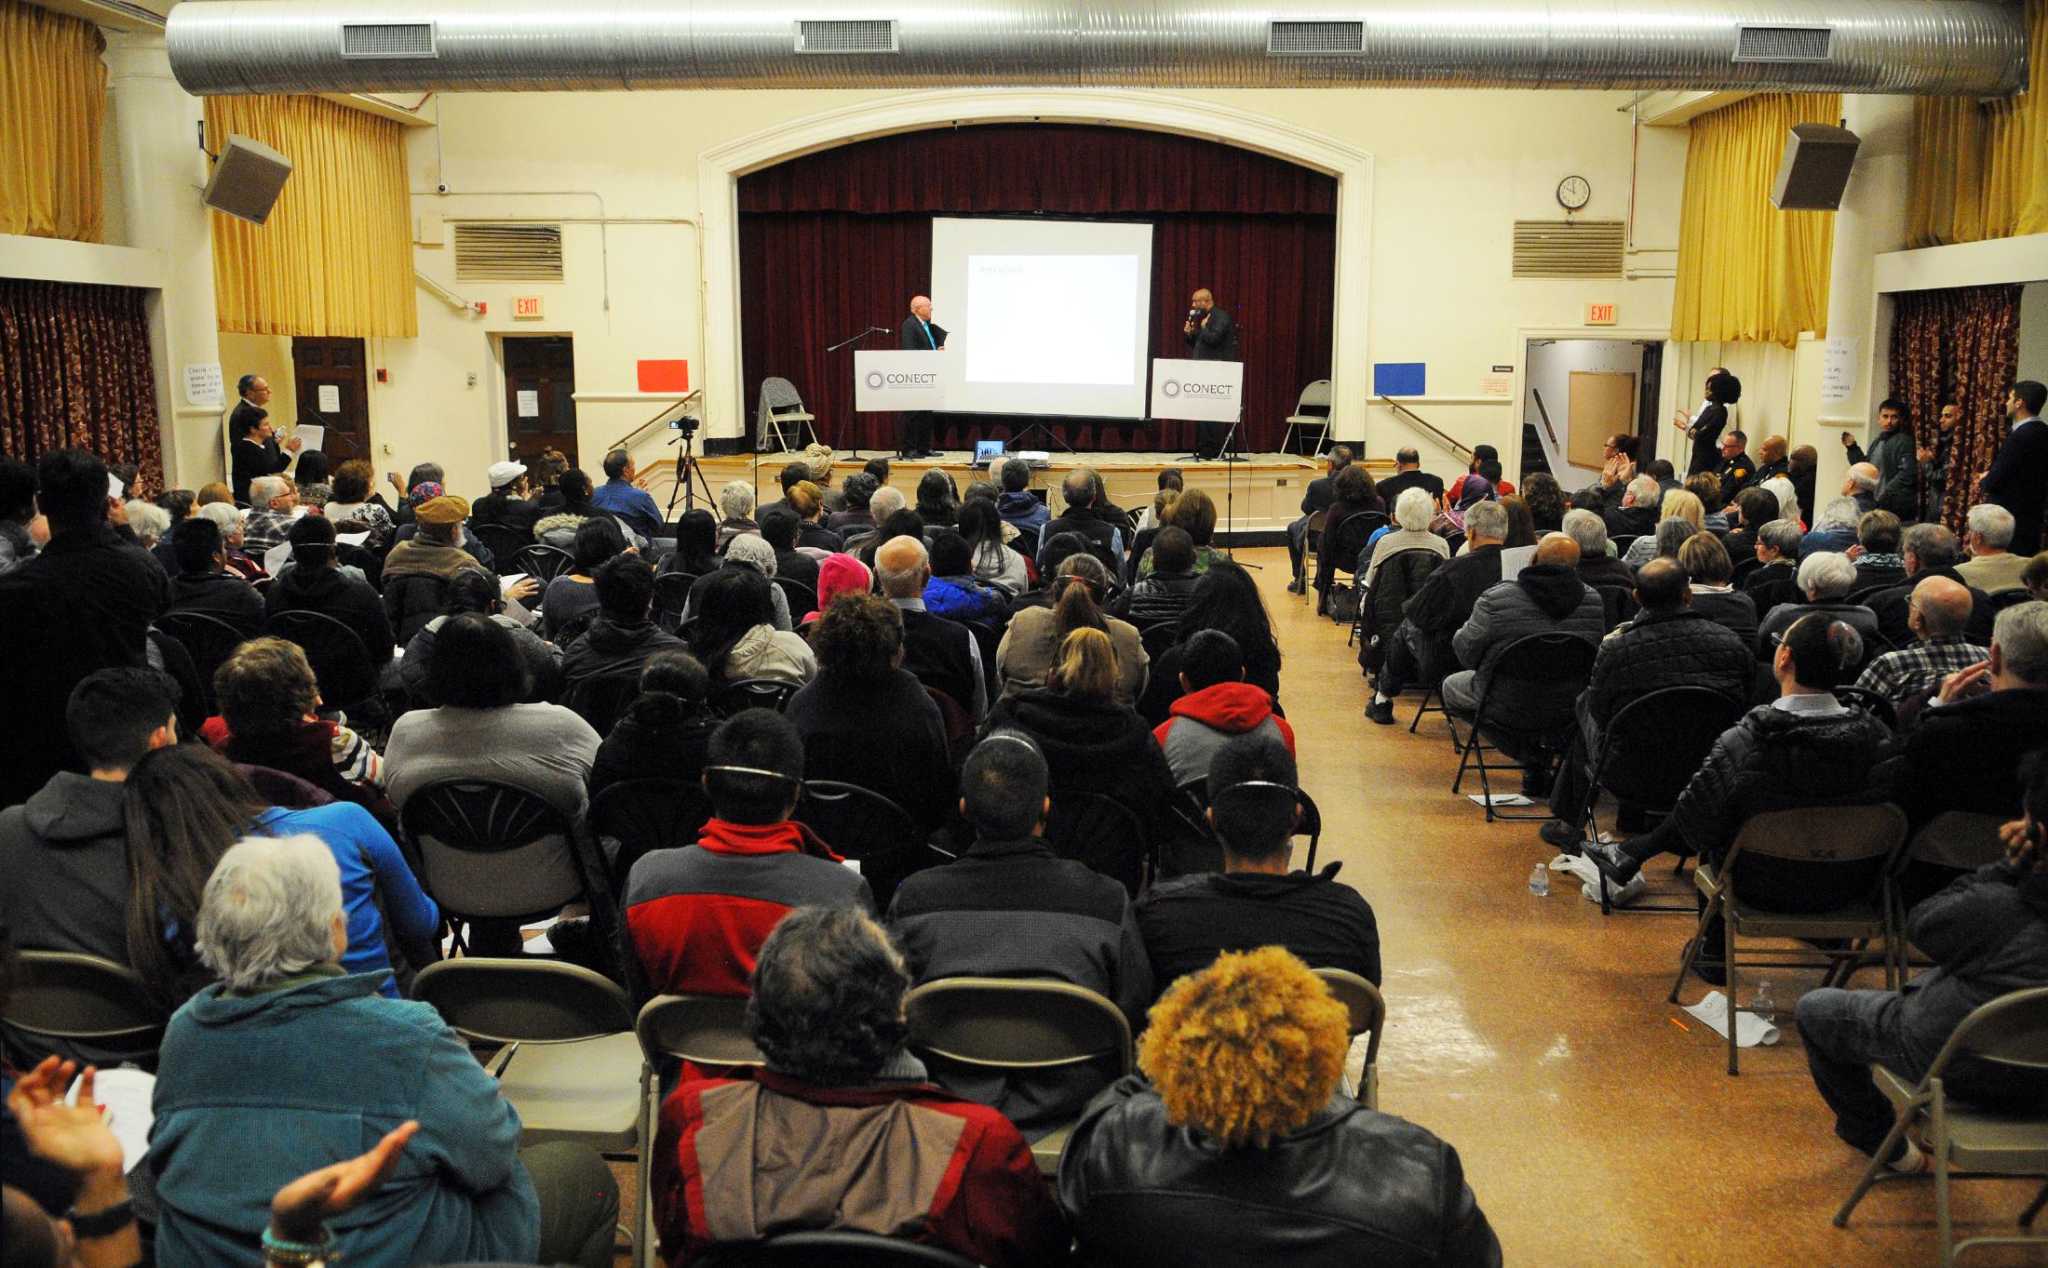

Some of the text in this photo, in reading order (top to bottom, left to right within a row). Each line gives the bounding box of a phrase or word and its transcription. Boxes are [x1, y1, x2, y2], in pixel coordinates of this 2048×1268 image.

[518, 298, 538, 314] EXIT
[591, 306, 614, 320] EXIT
[886, 373, 937, 384] CONECT
[1183, 383, 1233, 394] CONECT
